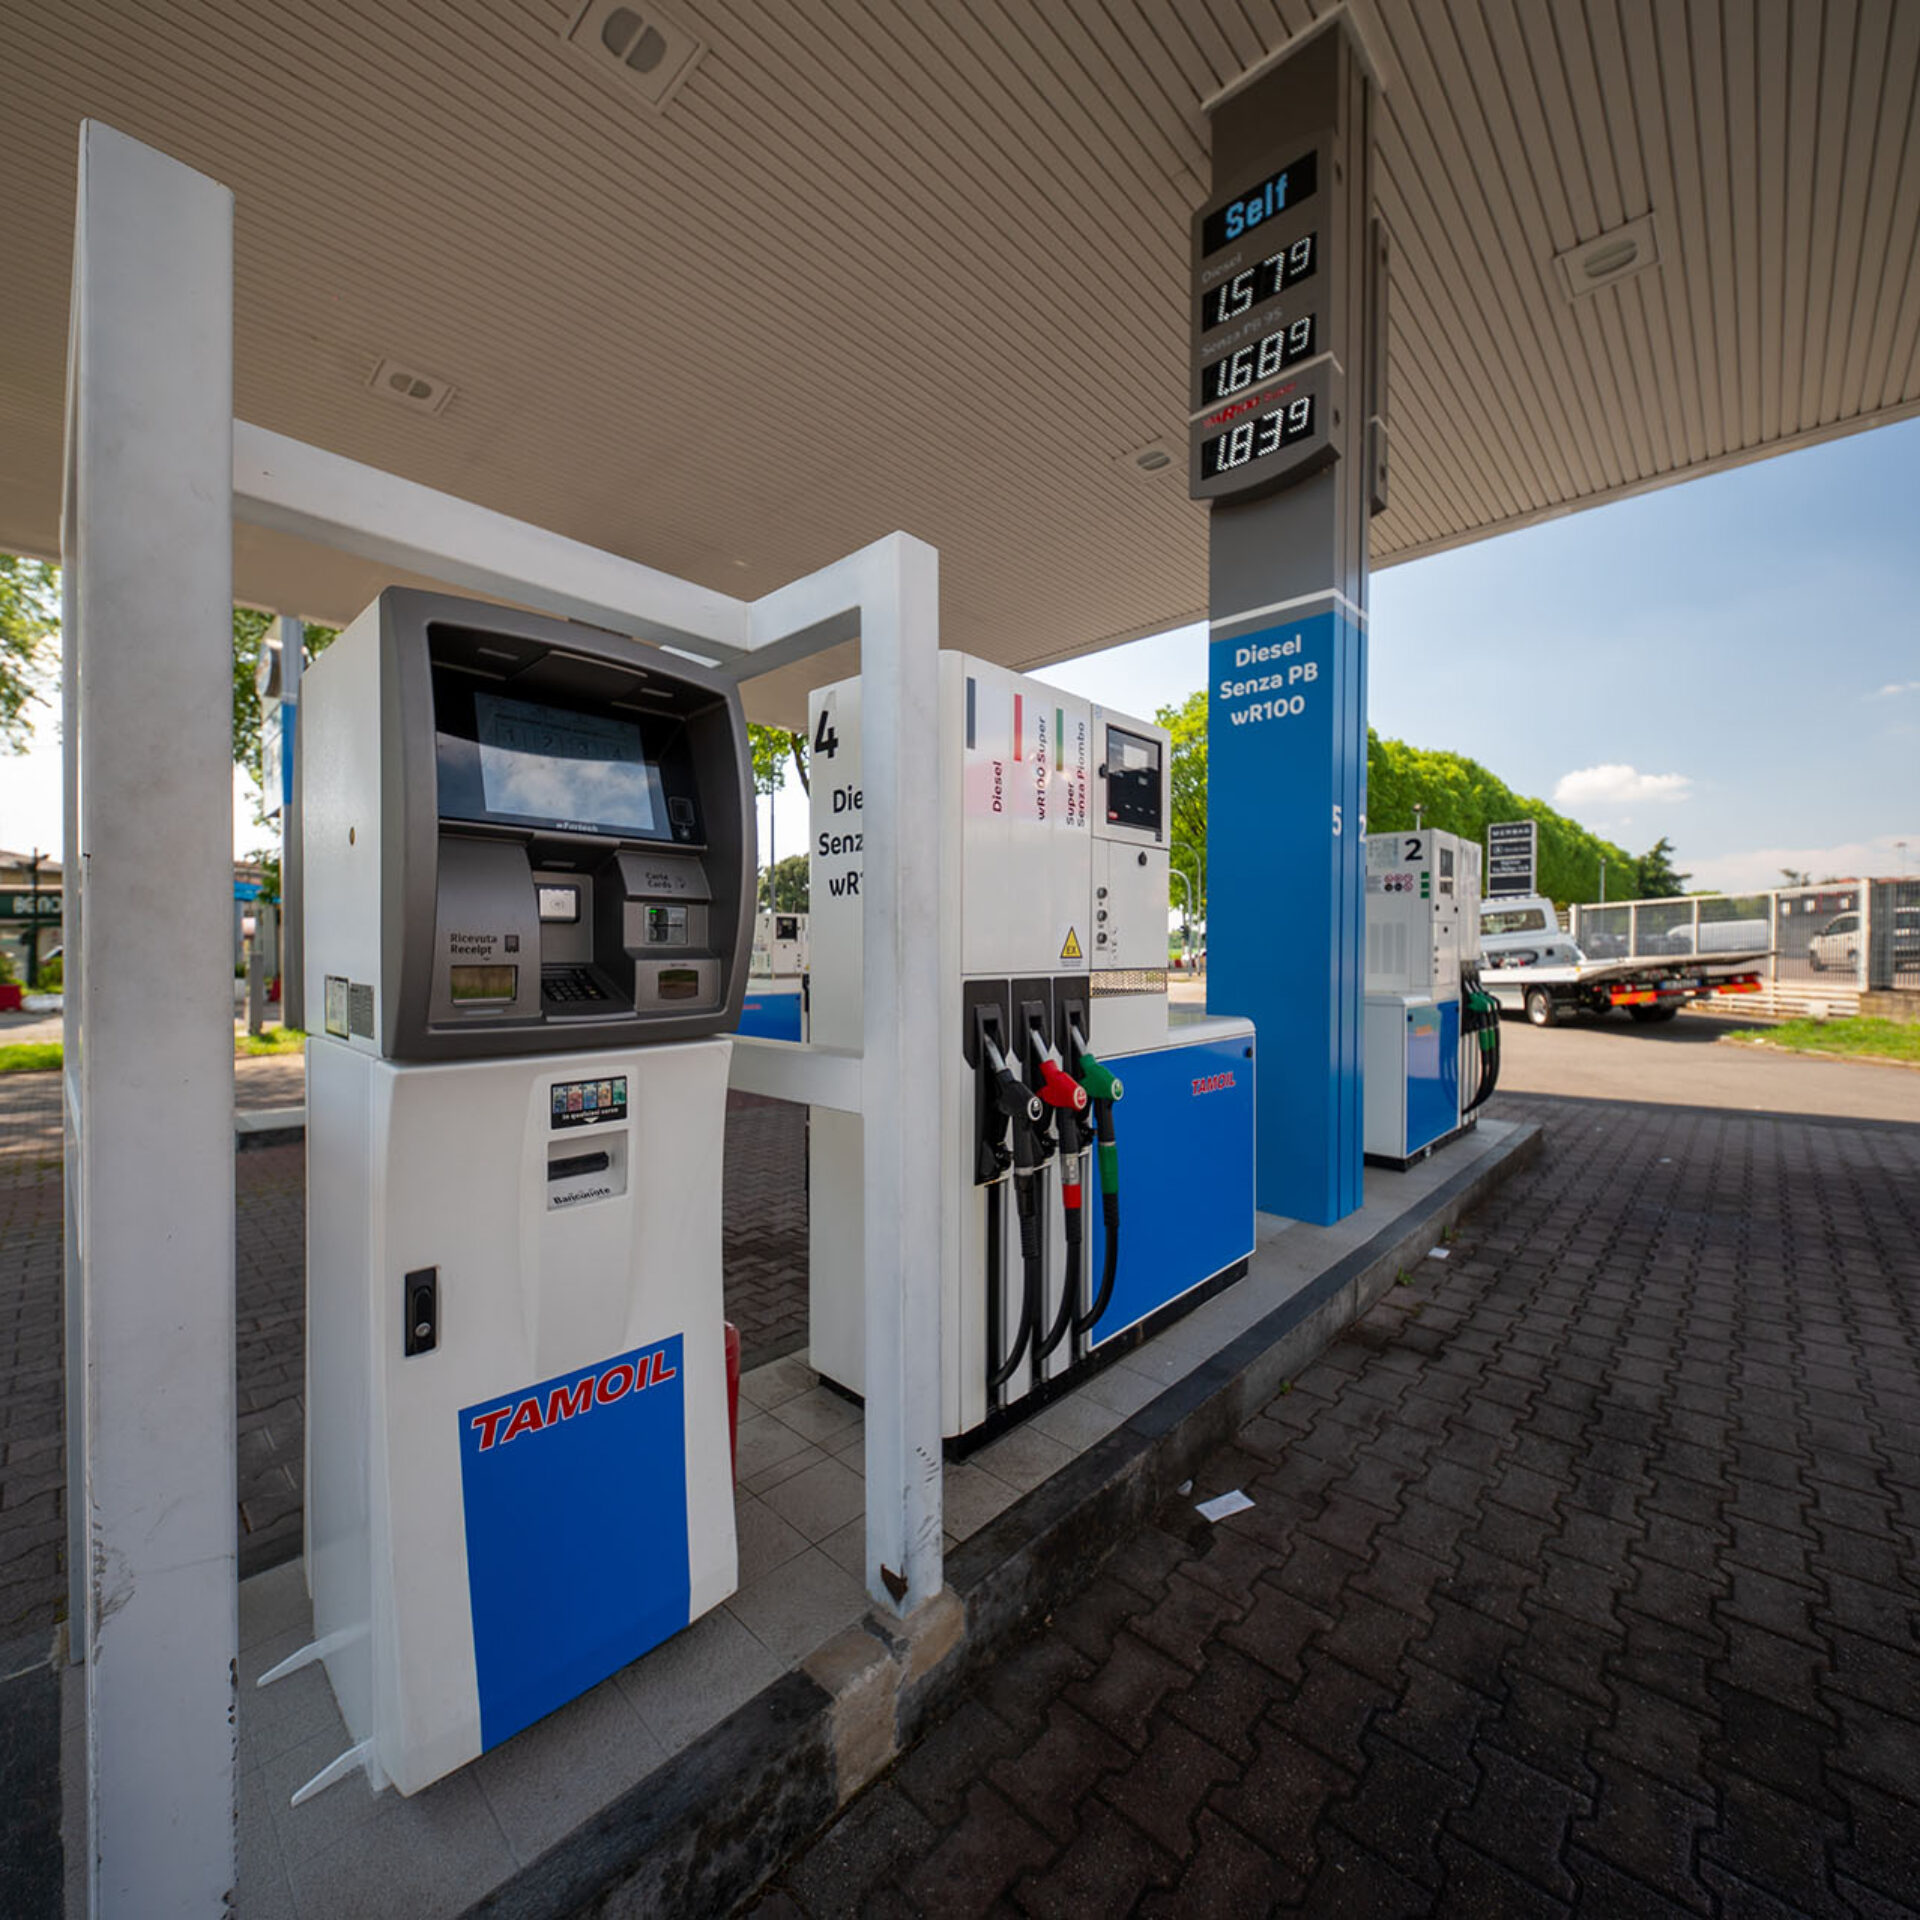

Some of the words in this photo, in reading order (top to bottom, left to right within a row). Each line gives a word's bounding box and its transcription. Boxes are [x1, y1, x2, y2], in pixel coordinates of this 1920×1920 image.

[1225, 173, 1288, 240] Self
[1202, 253, 1242, 284] Diesel
[1235, 634, 1302, 667] Diesel
[1219, 673, 1283, 699] Senza
[1288, 662, 1318, 685] PB
[1231, 695, 1305, 726] wR100
[815, 710, 838, 759] 4
[1037, 716, 1047, 763] Super
[1077, 722, 1085, 779] Piombo
[992, 761, 1002, 813] Diesel
[1036, 767, 1045, 820] wR100
[1067, 782, 1076, 825] Super
[1077, 783, 1085, 827] Senza
[1332, 805, 1342, 836] 5
[1405, 838, 1423, 861] 2
[450, 933, 498, 943] Ricevuta
[450, 944, 492, 956] Receipt
[1192, 1070, 1236, 1096] TAMOIL
[471, 1350, 676, 1452] TAMOIL
